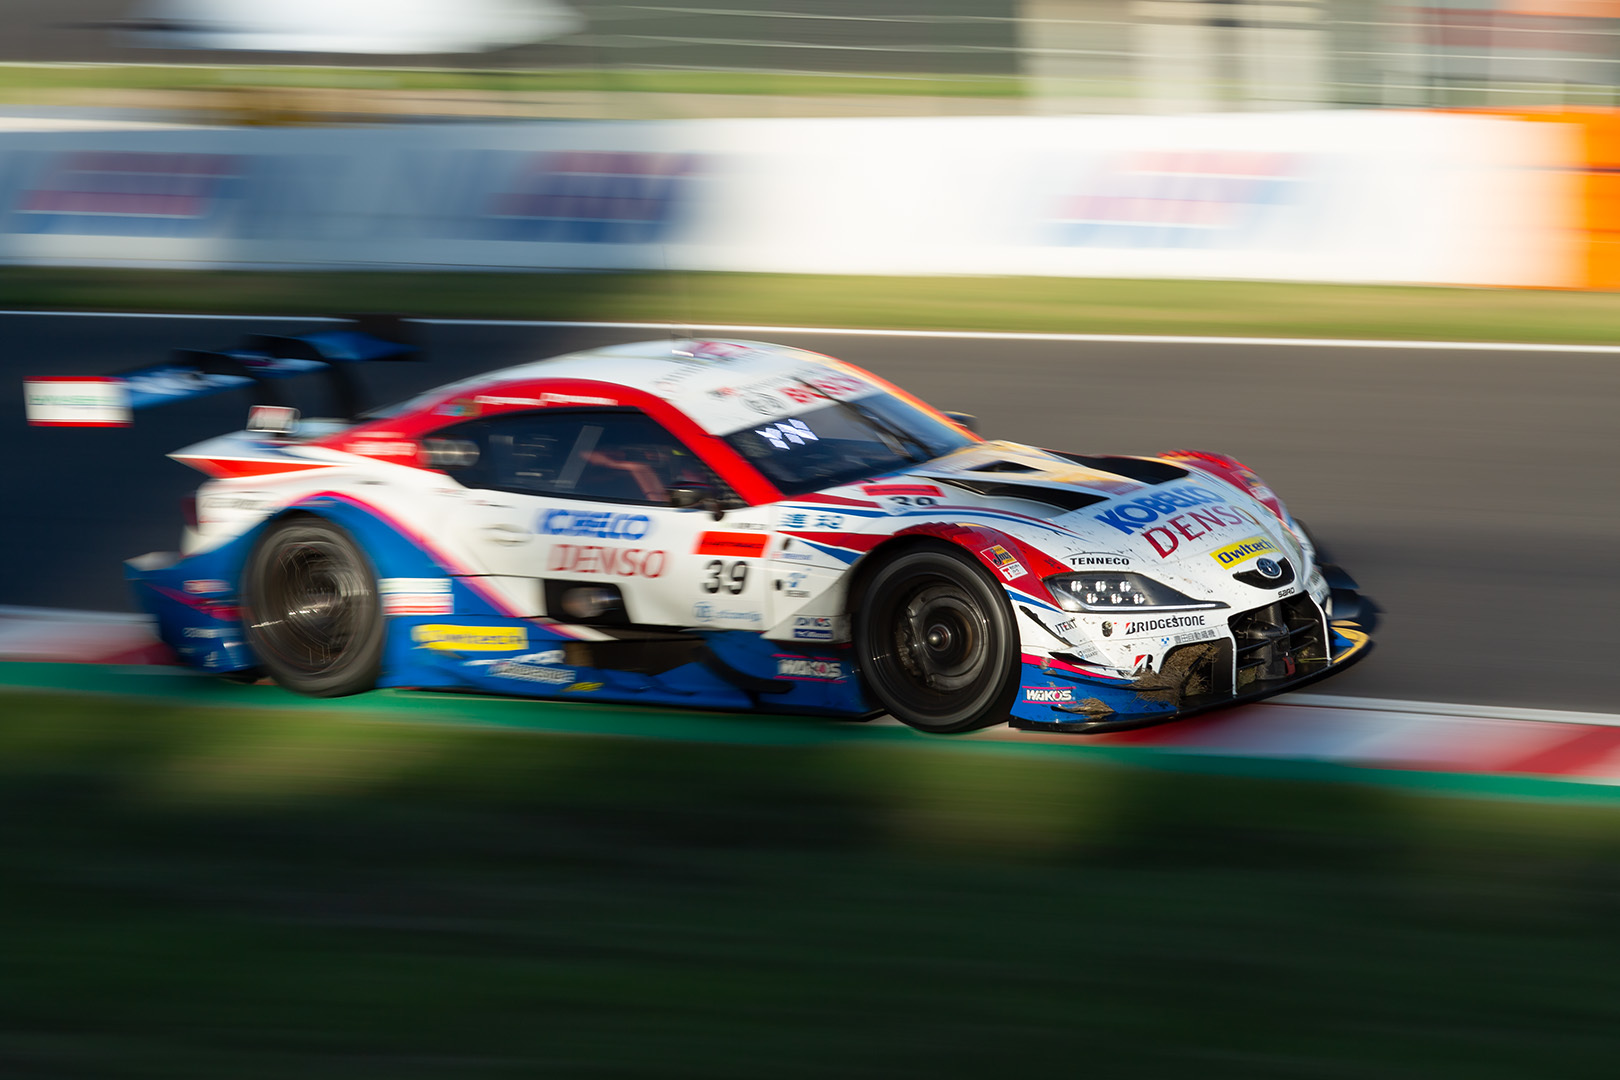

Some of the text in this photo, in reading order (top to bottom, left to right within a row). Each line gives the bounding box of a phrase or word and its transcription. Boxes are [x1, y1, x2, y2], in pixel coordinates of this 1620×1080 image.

[1094, 485, 1227, 536] KOBELCO
[1141, 504, 1261, 559] DENSO
[1069, 557, 1130, 566] TENNECO
[1217, 539, 1276, 565] Owltech
[702, 558, 750, 595] 39
[1054, 618, 1077, 635] JTEKT
[1124, 615, 1206, 636] BRIDGESTONE
